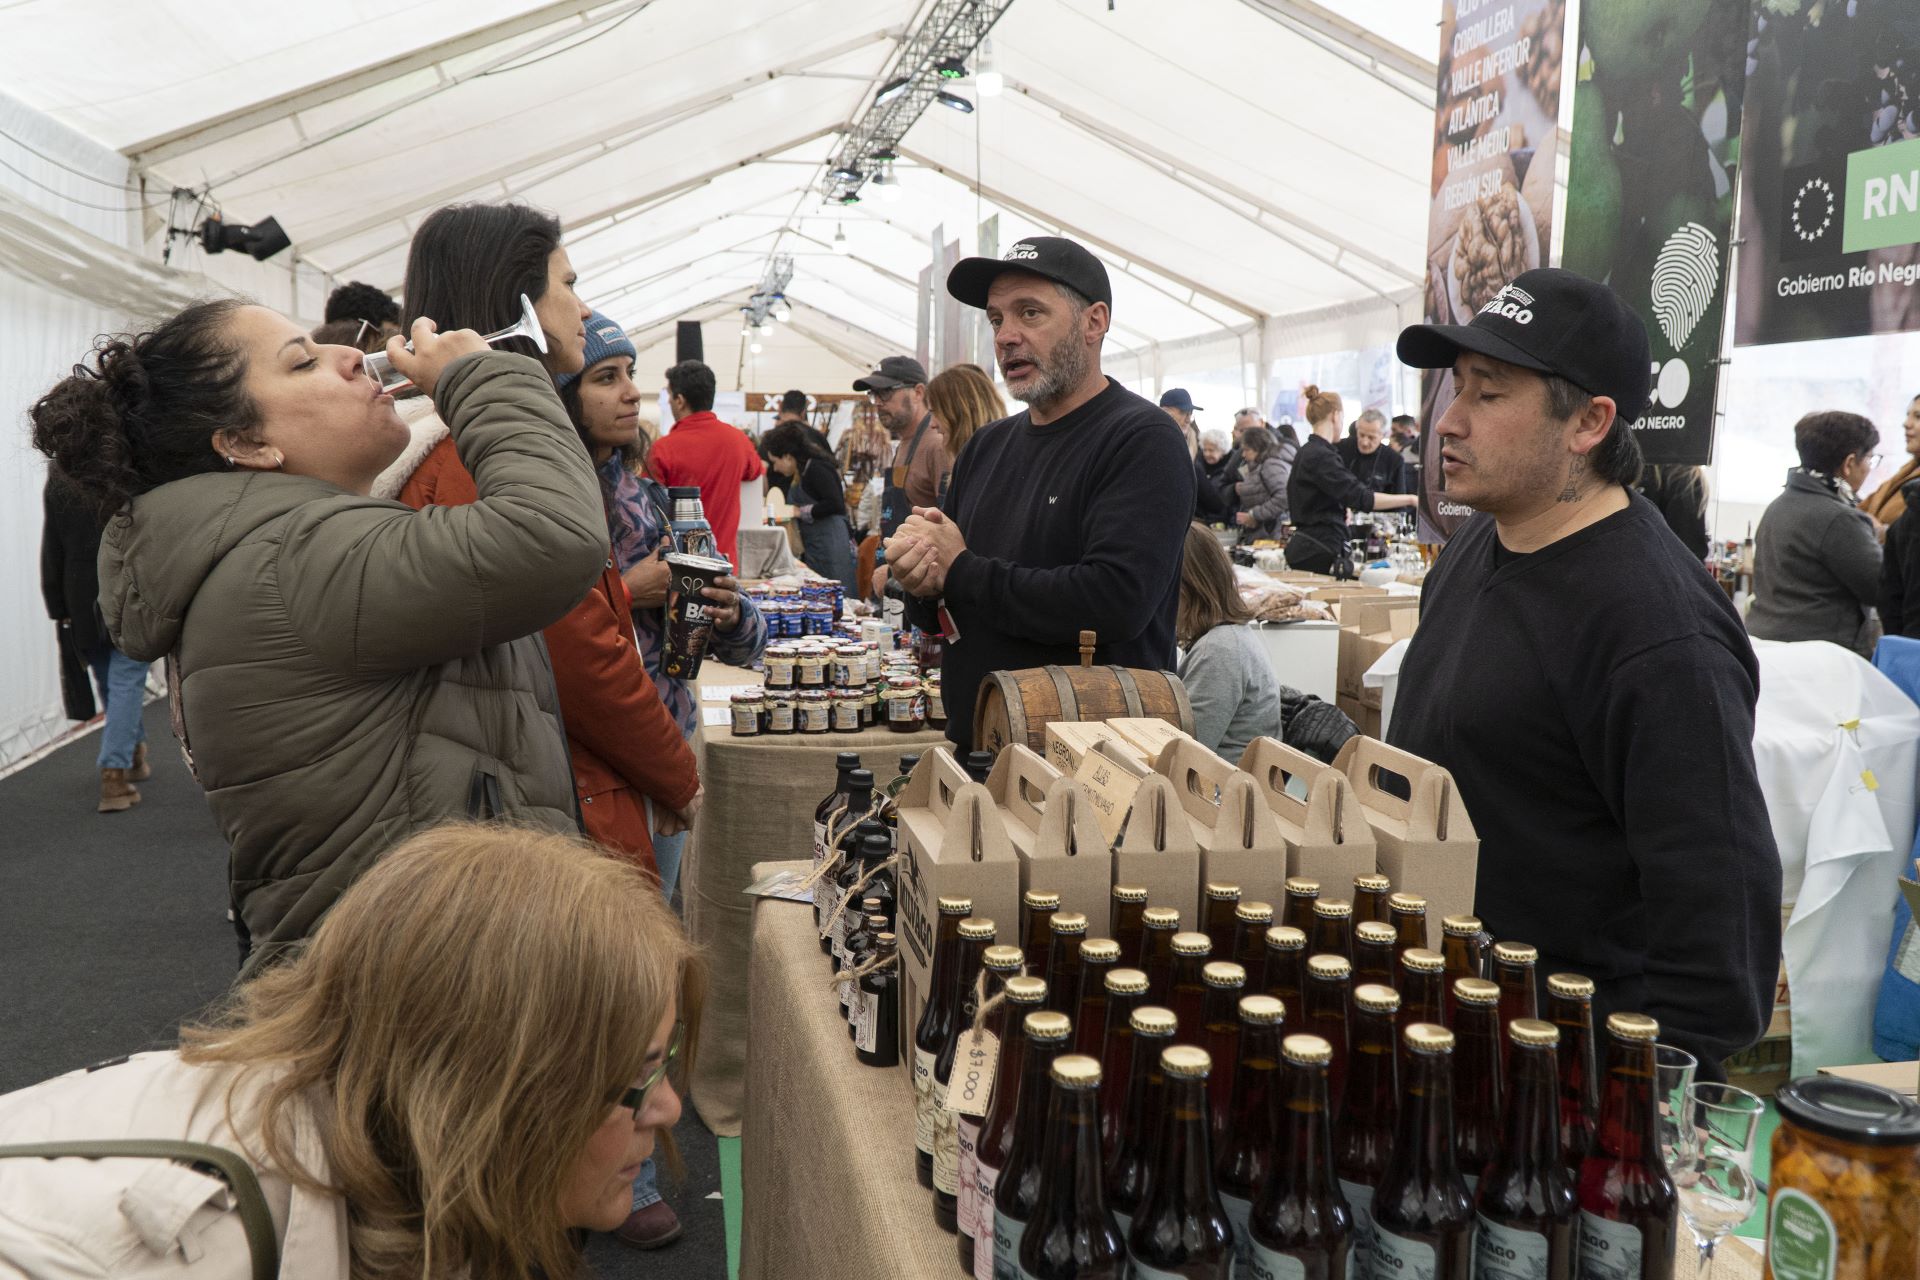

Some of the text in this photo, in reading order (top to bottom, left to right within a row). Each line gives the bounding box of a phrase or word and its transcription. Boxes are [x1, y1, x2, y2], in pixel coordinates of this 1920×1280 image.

[1453, 4, 1514, 58] CORDILLERA
[1451, 36, 1531, 96] VALLE INFERIOR
[1448, 88, 1500, 136] ATLÁNTICA
[1447, 126, 1511, 173] VALLE MEDIO
[1480, 168, 1503, 200] SUR
[1863, 169, 1920, 221] RN
[1777, 272, 1845, 297] Gobierno
[1848, 265, 1876, 288] Río
[1647, 415, 1686, 430] NEGRO
[1437, 501, 1472, 517] Gobierno
[963, 1049, 986, 1101] $7.000
